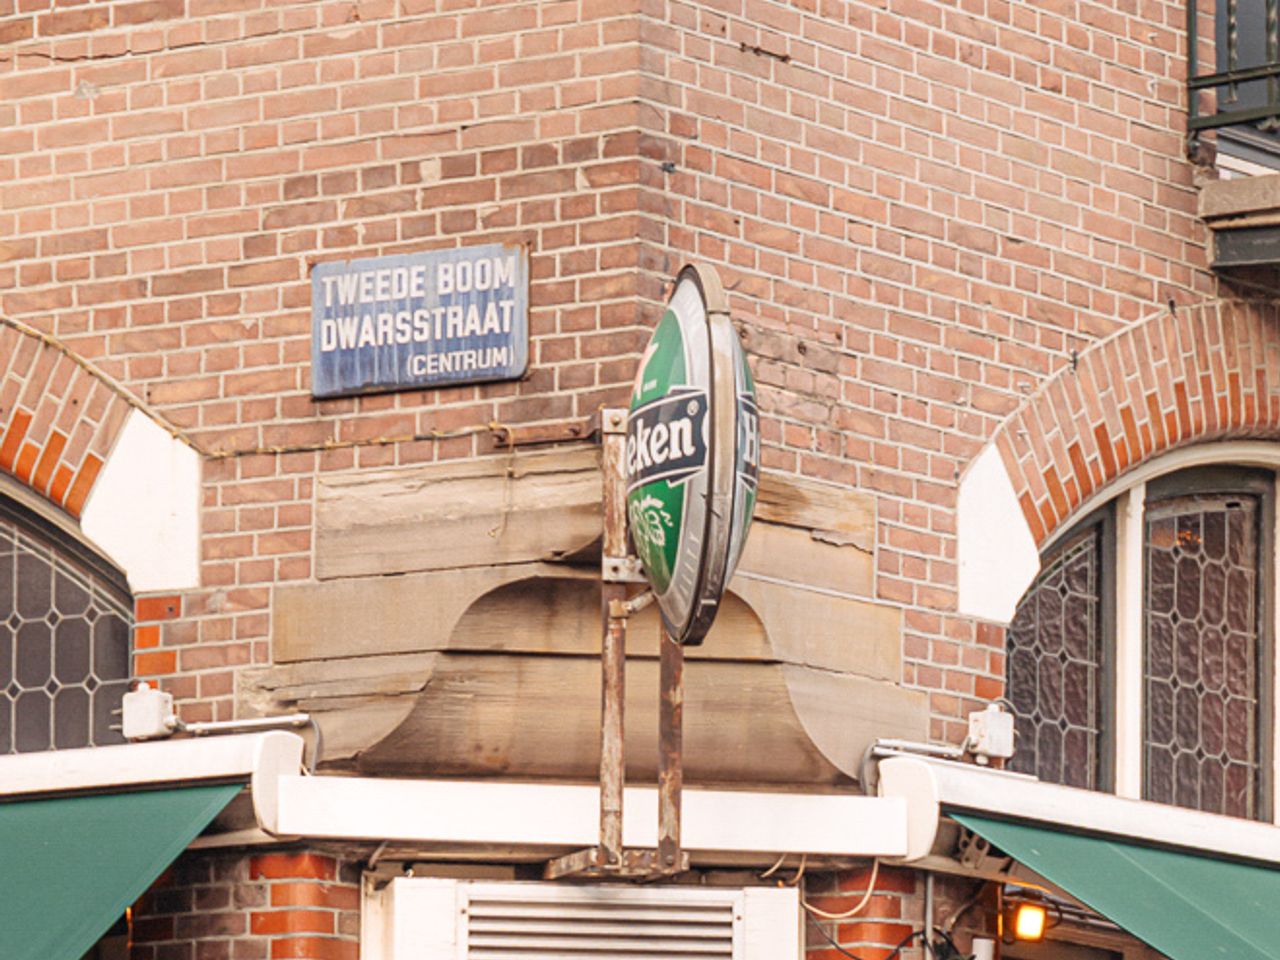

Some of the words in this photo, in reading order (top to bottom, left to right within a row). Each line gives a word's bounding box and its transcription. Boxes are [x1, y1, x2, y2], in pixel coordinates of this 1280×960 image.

[322, 264, 426, 307] TWEEDE
[436, 255, 516, 296] BOOM
[320, 300, 515, 352] DWARSSTRAAT
[406, 346, 515, 378] (CENTRUM)
[626, 416, 696, 475] eken
